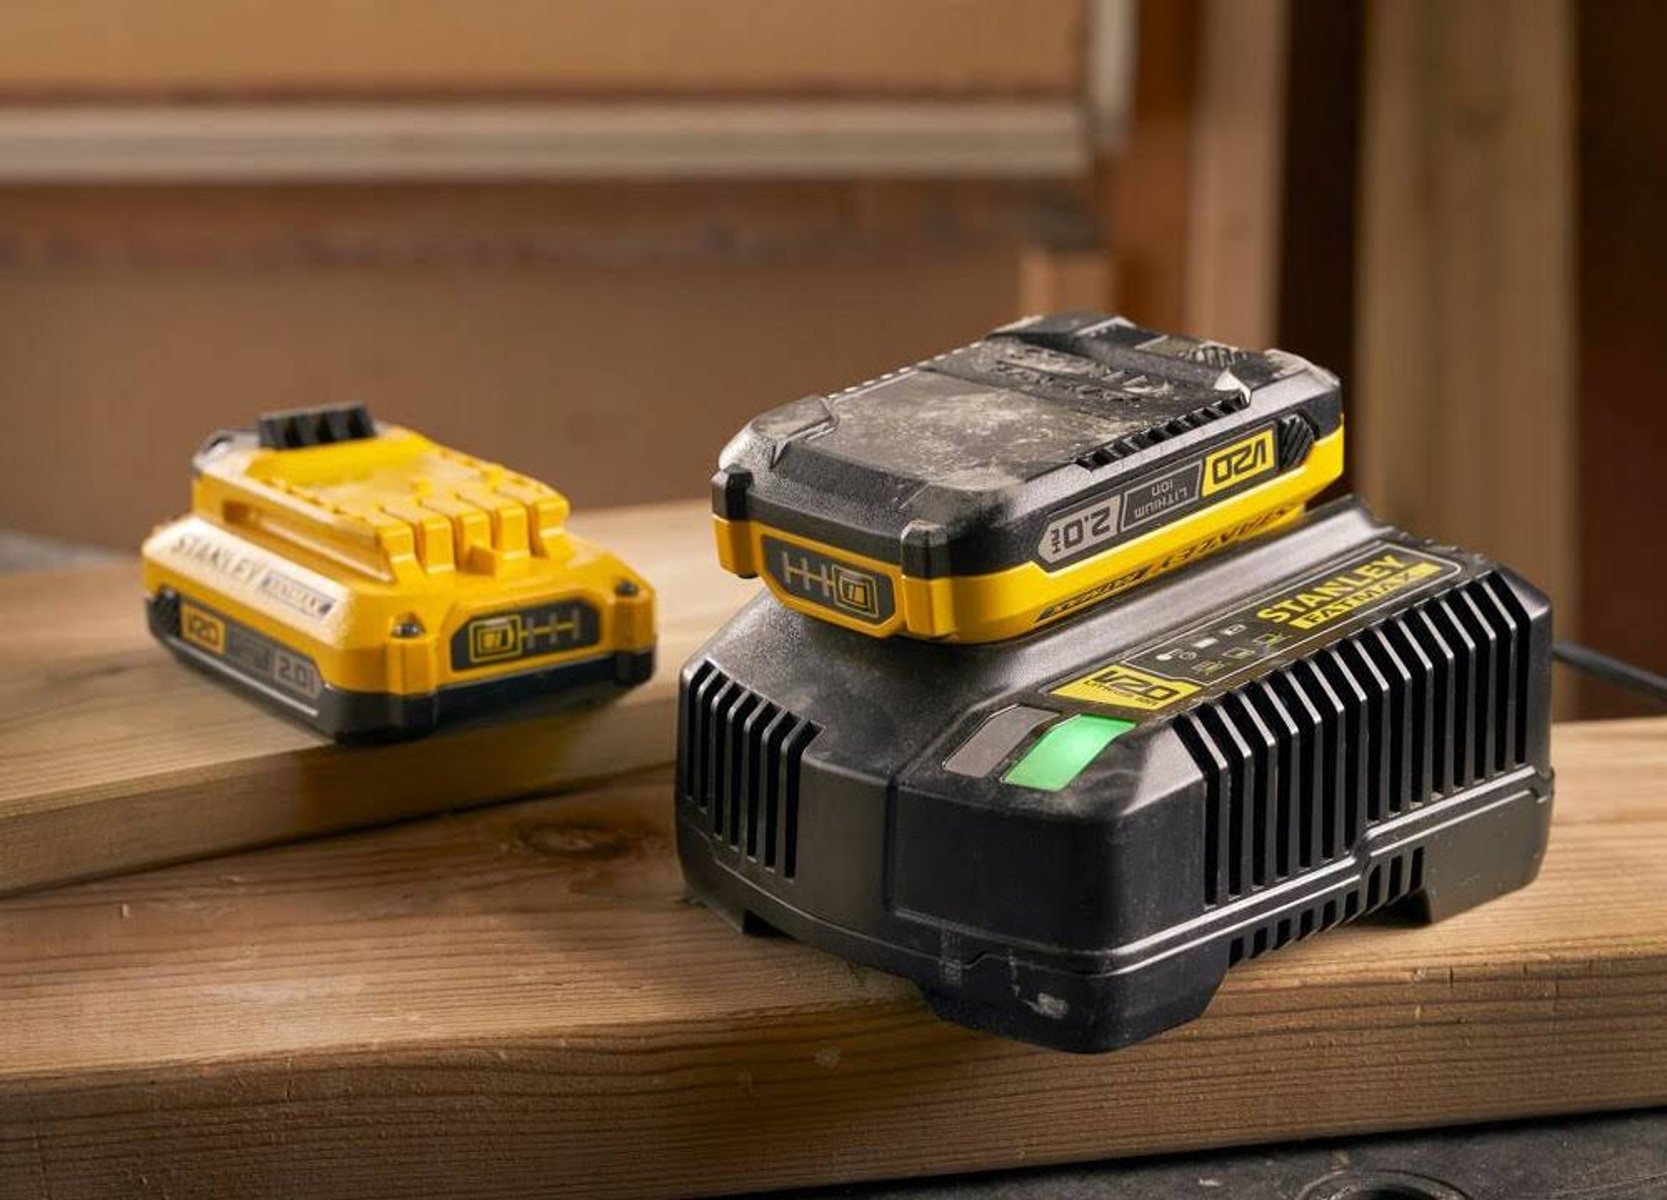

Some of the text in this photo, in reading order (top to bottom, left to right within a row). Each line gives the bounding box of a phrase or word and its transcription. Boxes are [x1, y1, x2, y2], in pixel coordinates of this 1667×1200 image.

[1212, 438, 1266, 485] V20
[1062, 506, 1111, 546] 2.0
[1256, 554, 1405, 623] STANLEY
[1092, 670, 1181, 701] V20
